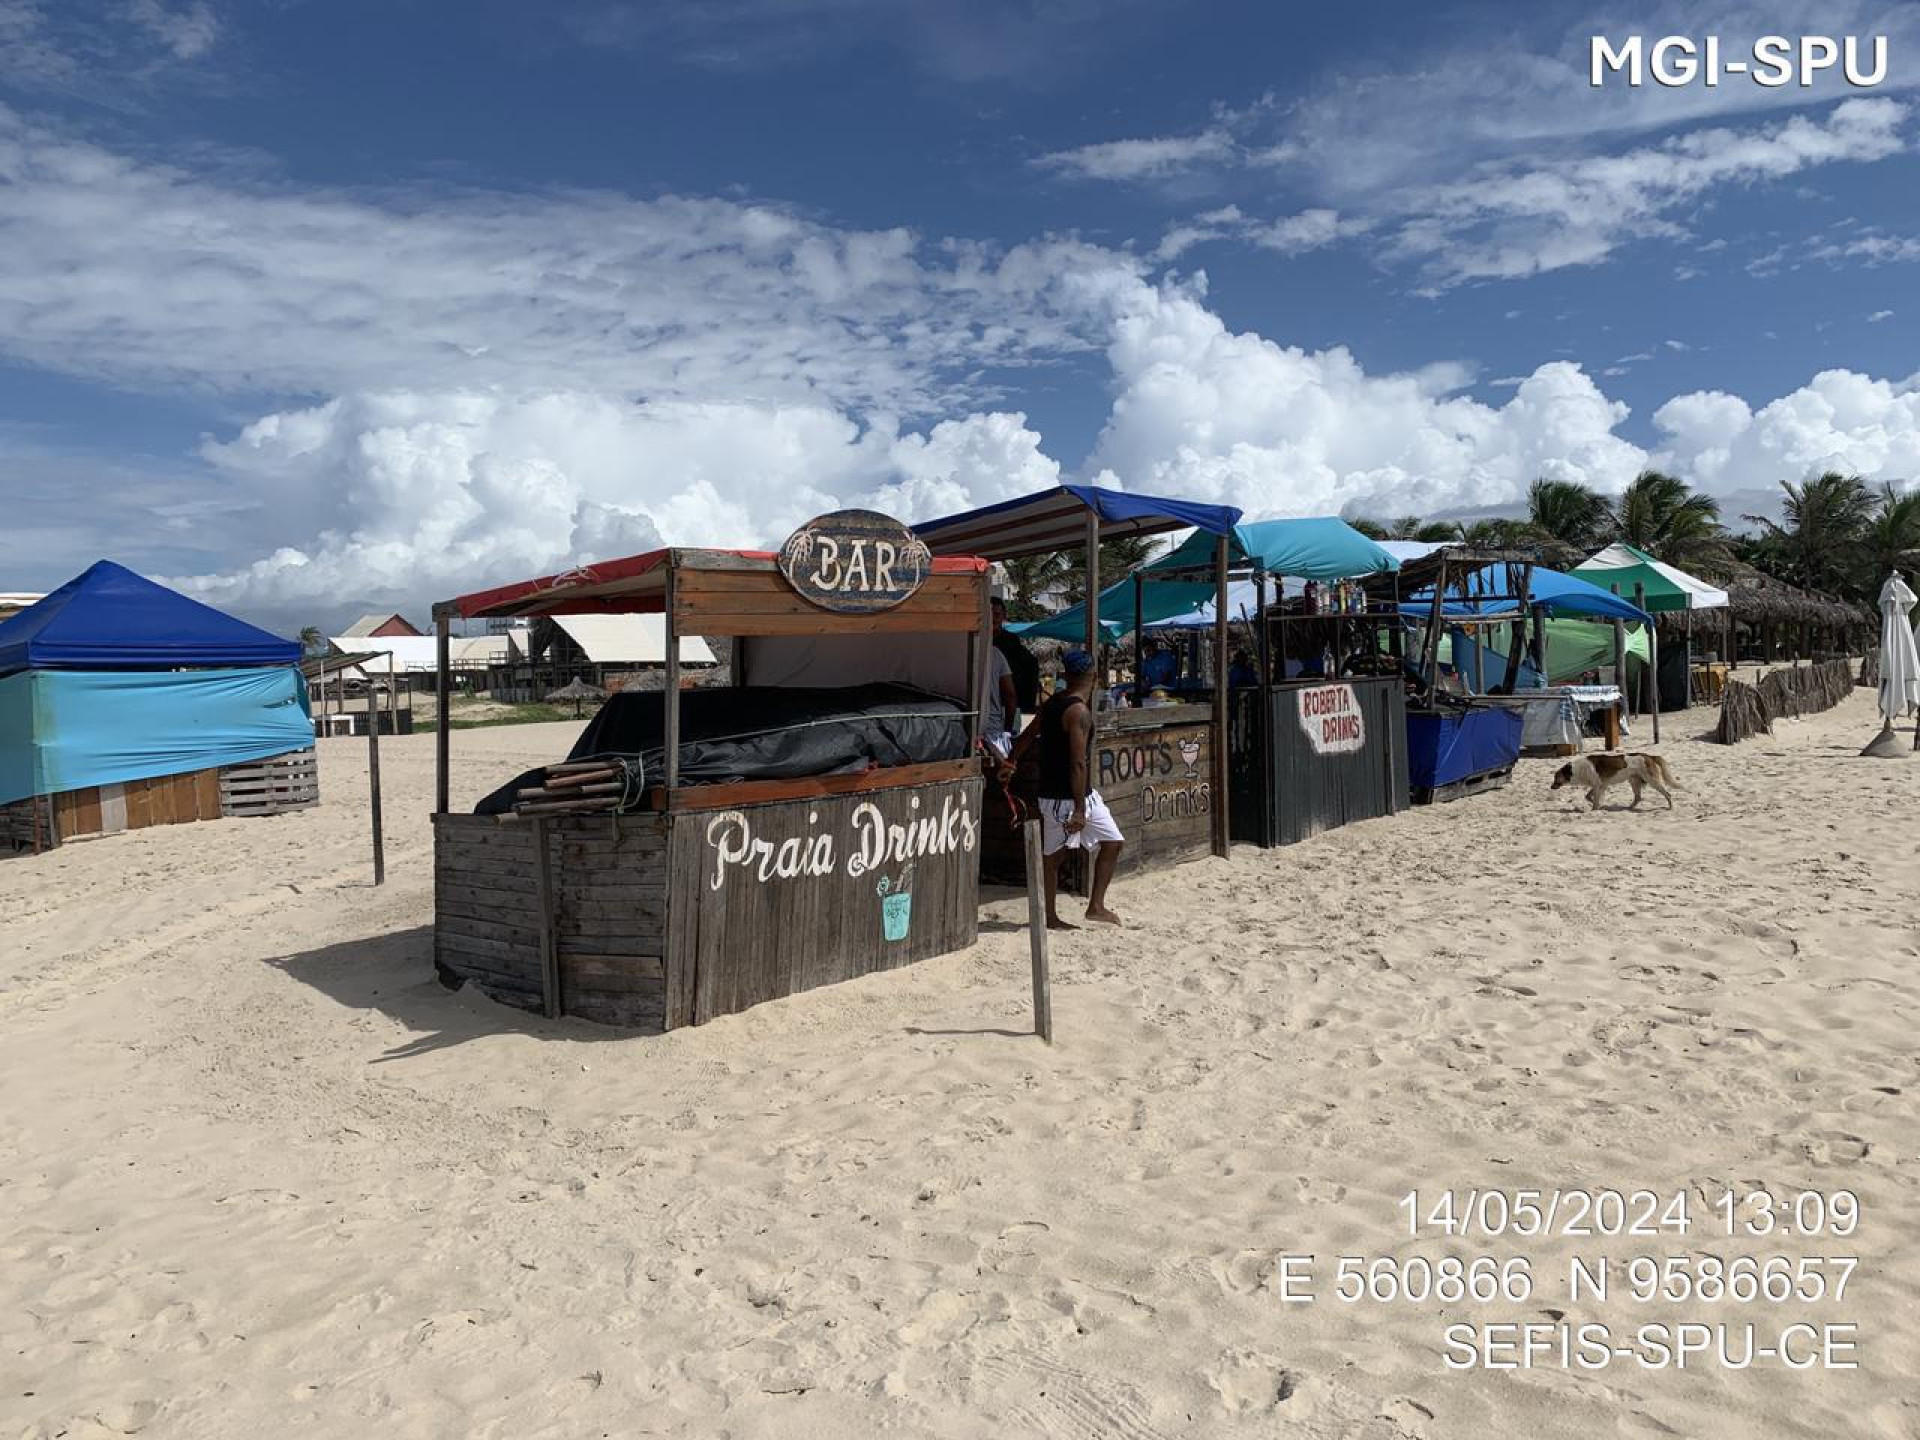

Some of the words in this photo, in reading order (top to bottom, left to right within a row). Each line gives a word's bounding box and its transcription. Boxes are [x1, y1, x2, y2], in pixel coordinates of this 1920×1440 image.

[809, 536, 898, 592] BAR
[1304, 687, 1350, 718] ROBERTA
[707, 810, 837, 891] Praia
[847, 791, 979, 877] Drink's
